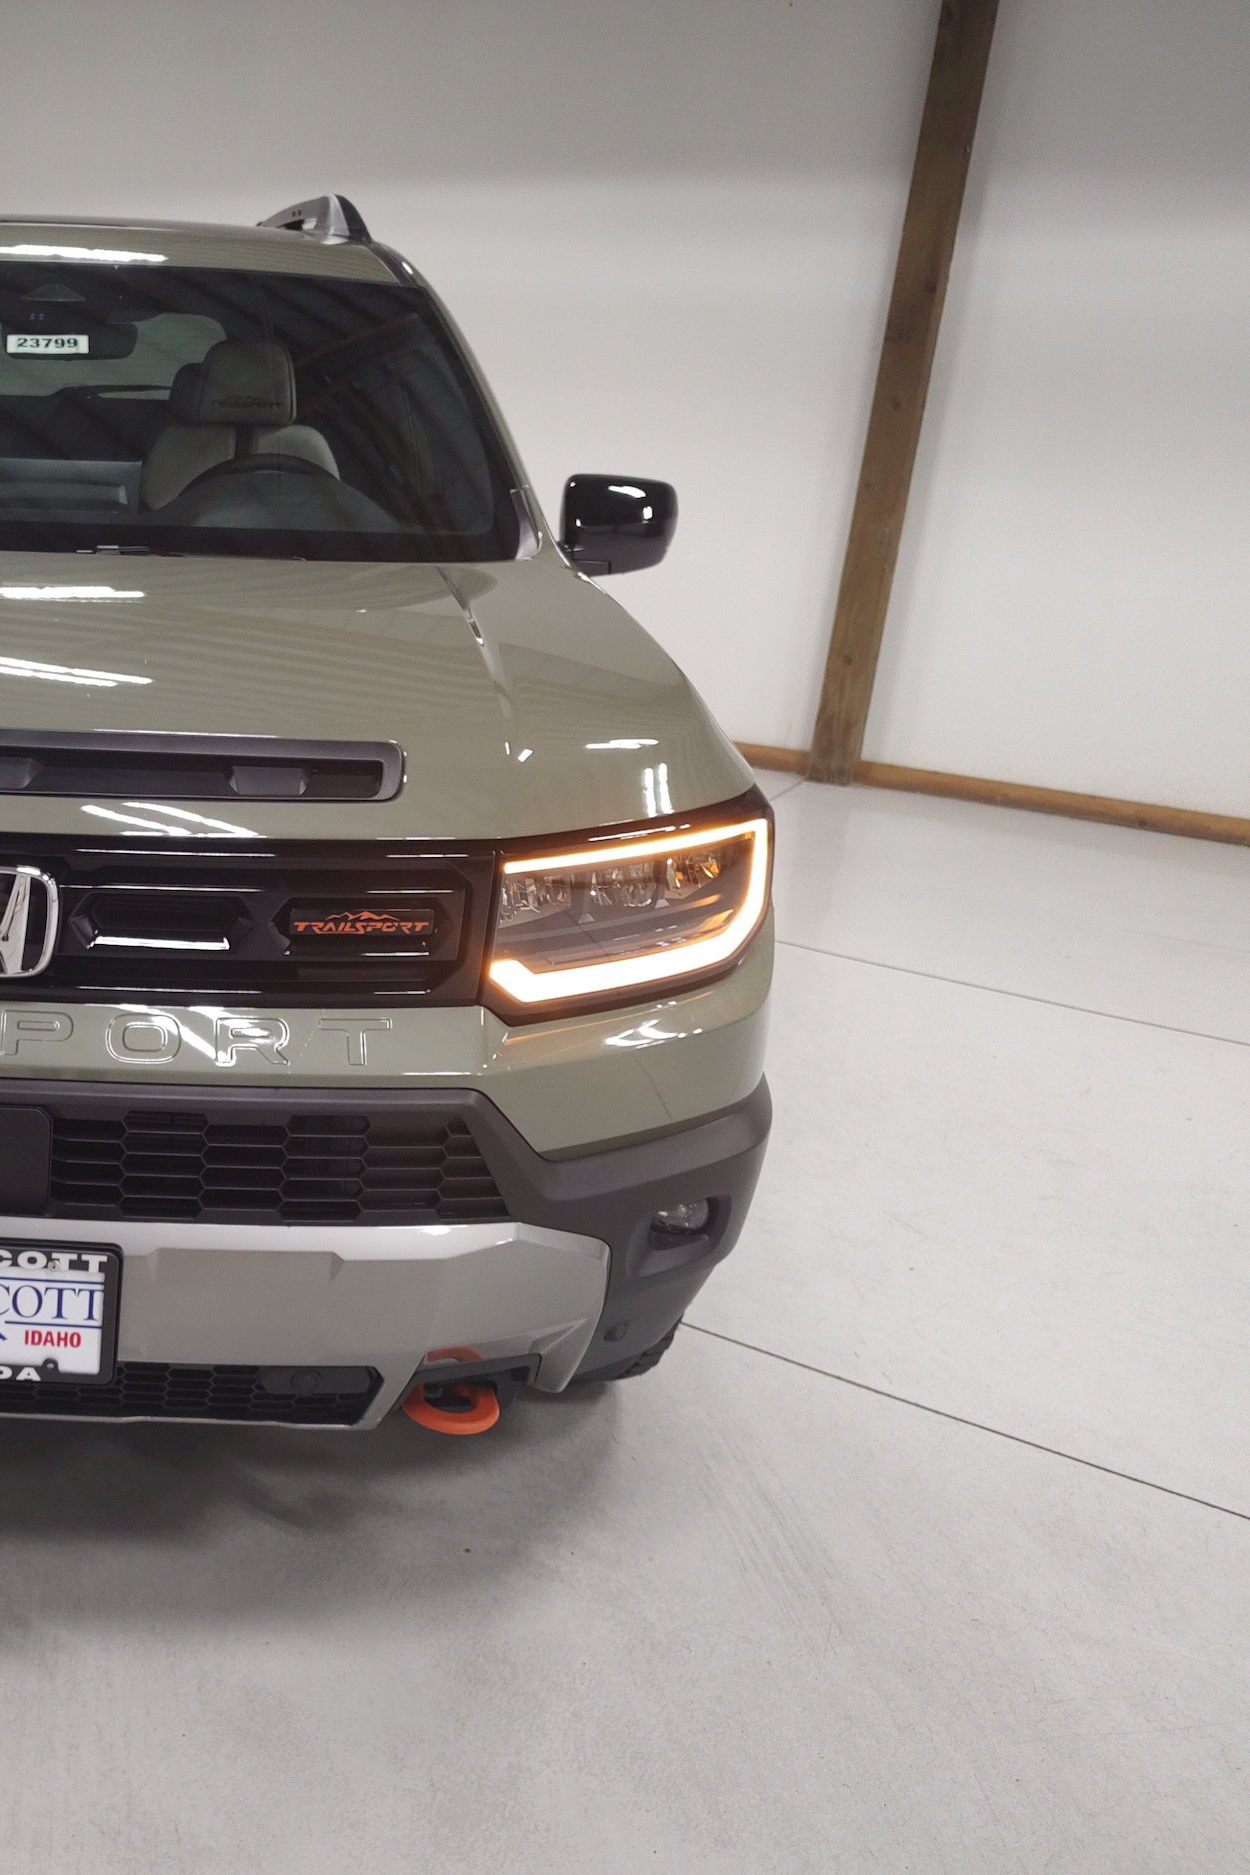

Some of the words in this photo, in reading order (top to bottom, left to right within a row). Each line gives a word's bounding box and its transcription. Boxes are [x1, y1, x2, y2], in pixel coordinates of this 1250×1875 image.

[16, 337, 78, 349] 23799
[293, 921, 430, 935] TRAILSPORT
[23, 1329, 82, 1349] IDAHO
